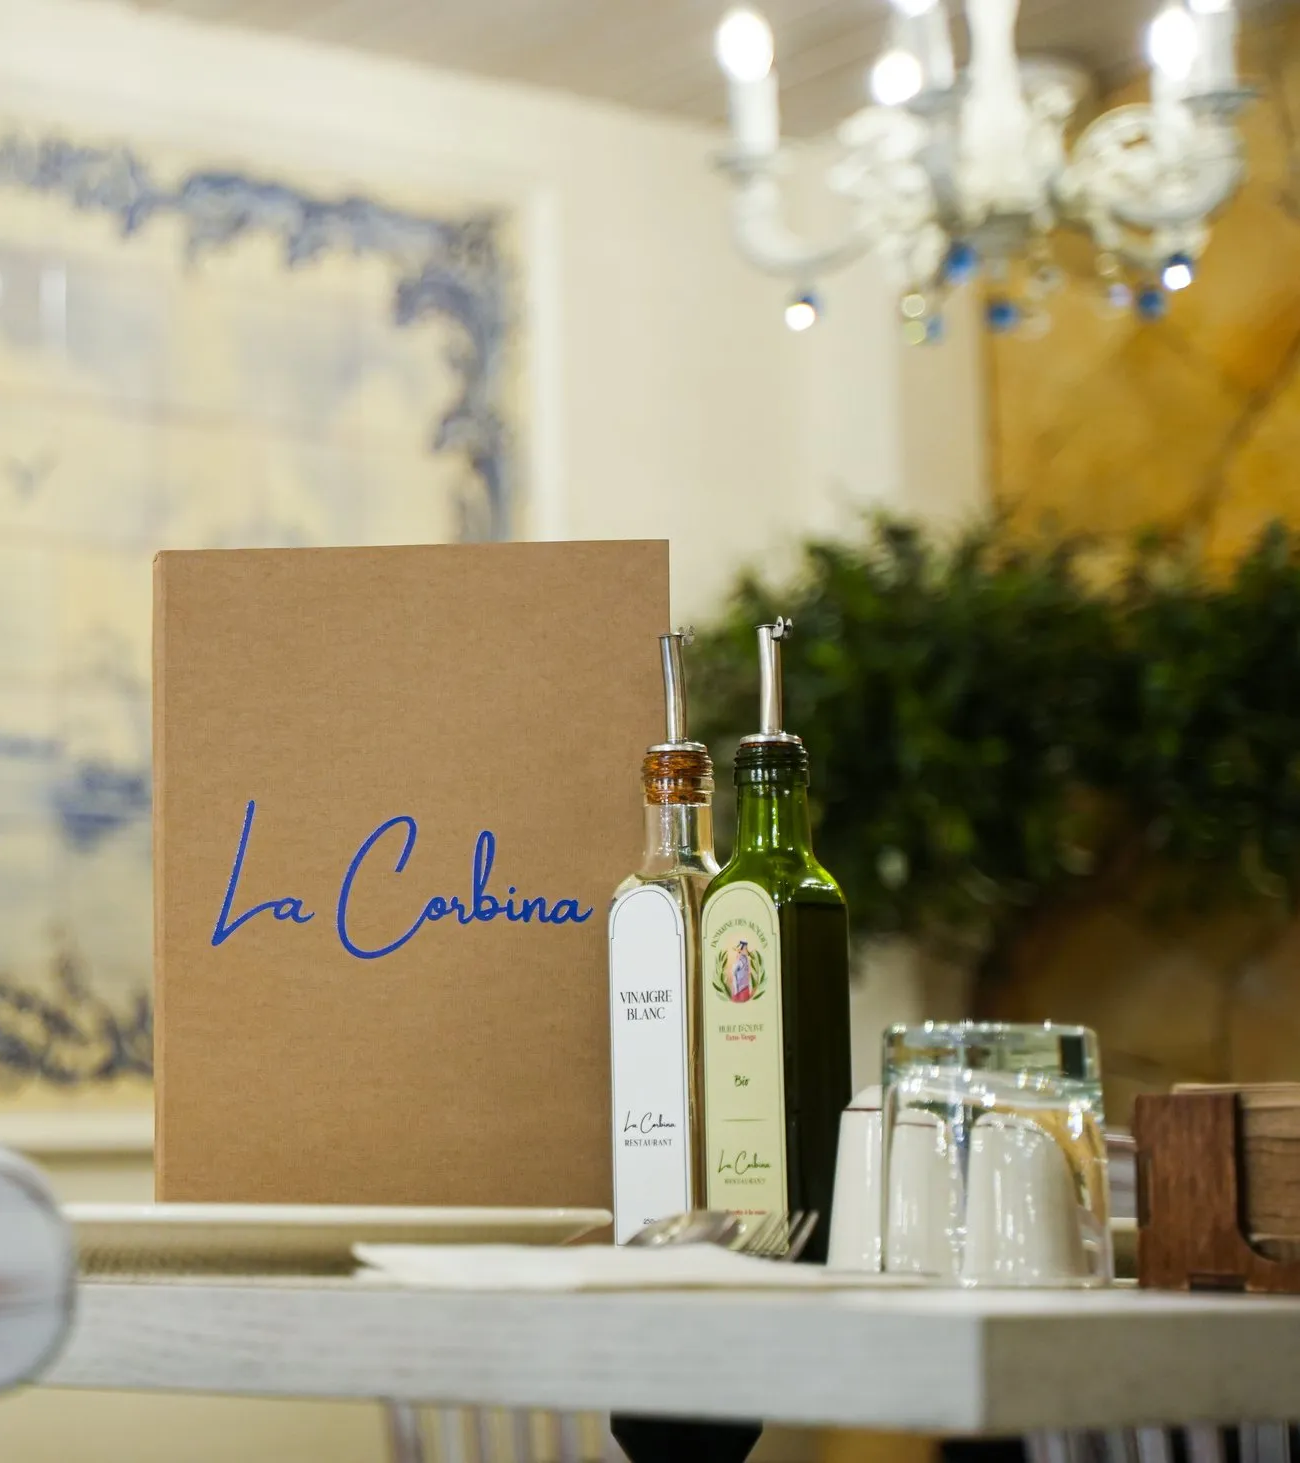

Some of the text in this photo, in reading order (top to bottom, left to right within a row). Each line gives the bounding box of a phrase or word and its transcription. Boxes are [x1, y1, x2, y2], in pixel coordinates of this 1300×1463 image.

[211, 800, 593, 959] La Corbina
[620, 989, 673, 1004] VINAIGRE
[627, 1006, 666, 1021] BLANC
[733, 1074, 750, 1088] Bio
[623, 1109, 677, 1134] La Corbina
[624, 1138, 673, 1147] RESTAURANT
[717, 1149, 733, 1174] La
